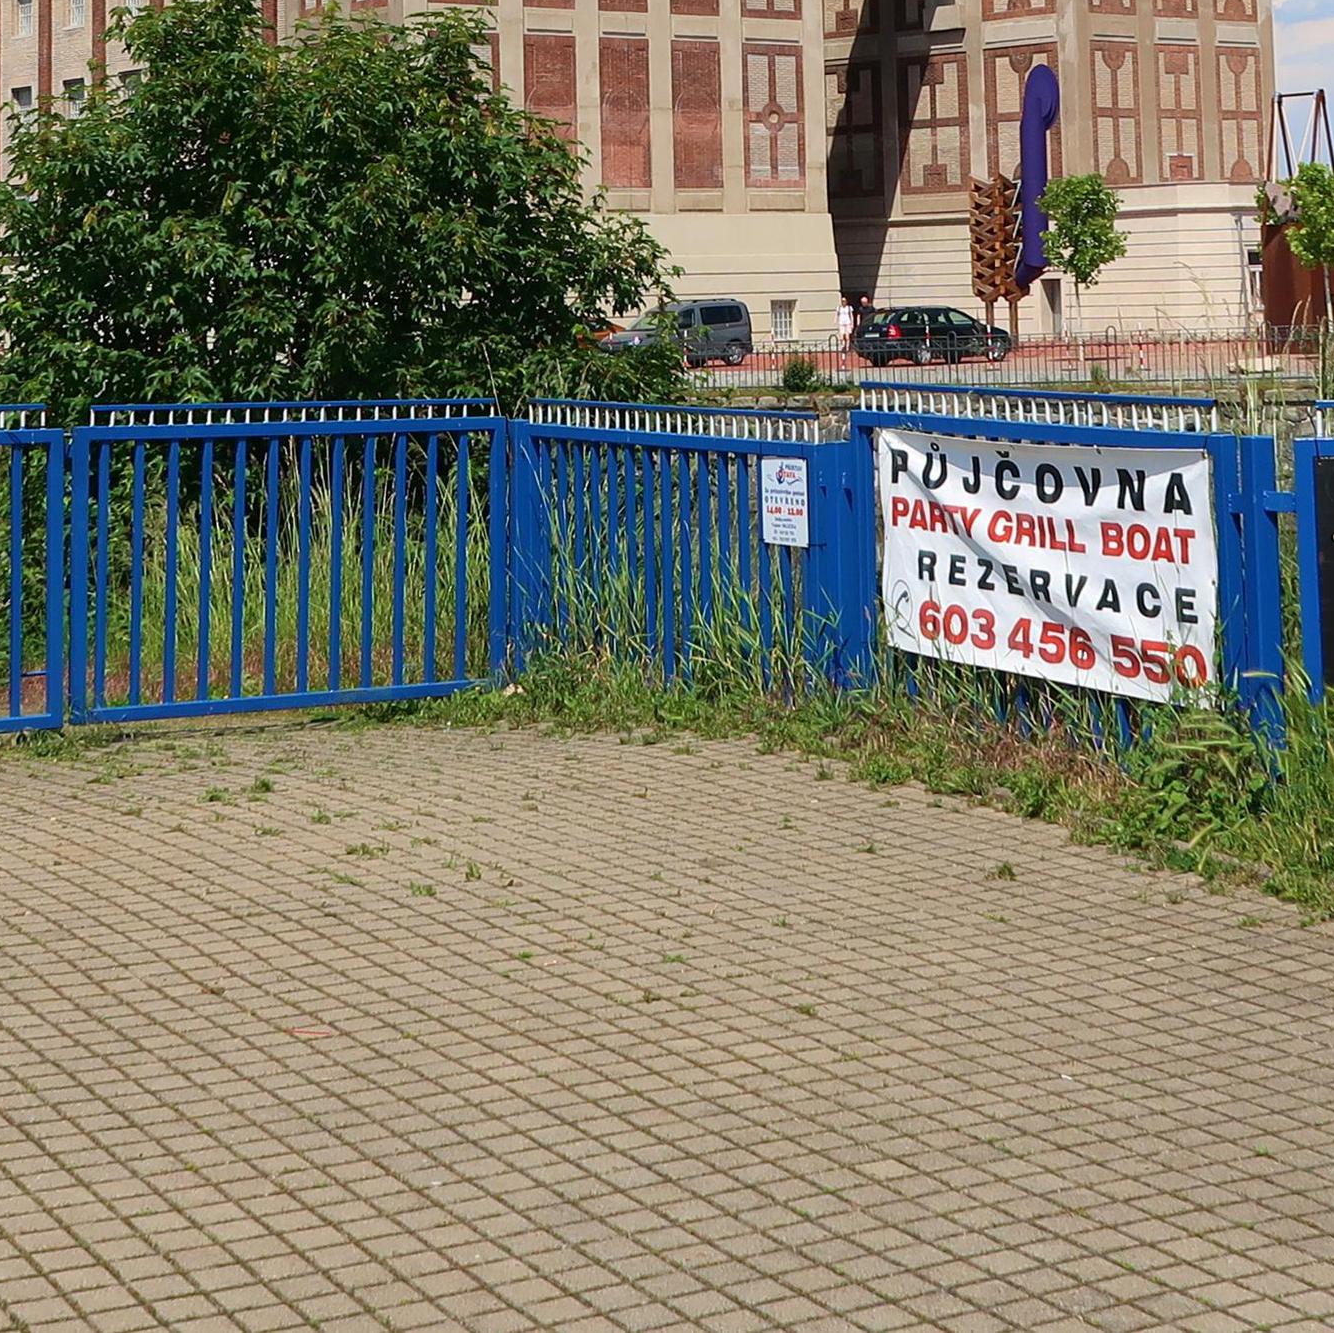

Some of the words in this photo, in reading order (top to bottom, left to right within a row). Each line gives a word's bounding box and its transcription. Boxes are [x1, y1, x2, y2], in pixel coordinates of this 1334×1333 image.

[890, 443, 1193, 515] PŮJČOVNA
[891, 497, 982, 538] PARTY
[987, 510, 1086, 554] GRILL
[1100, 522, 1196, 565] BOAT
[918, 550, 1199, 624] REZERVACE
[918, 600, 996, 650] 603
[1007, 618, 1096, 670] 456
[1110, 634, 1208, 688] 550
